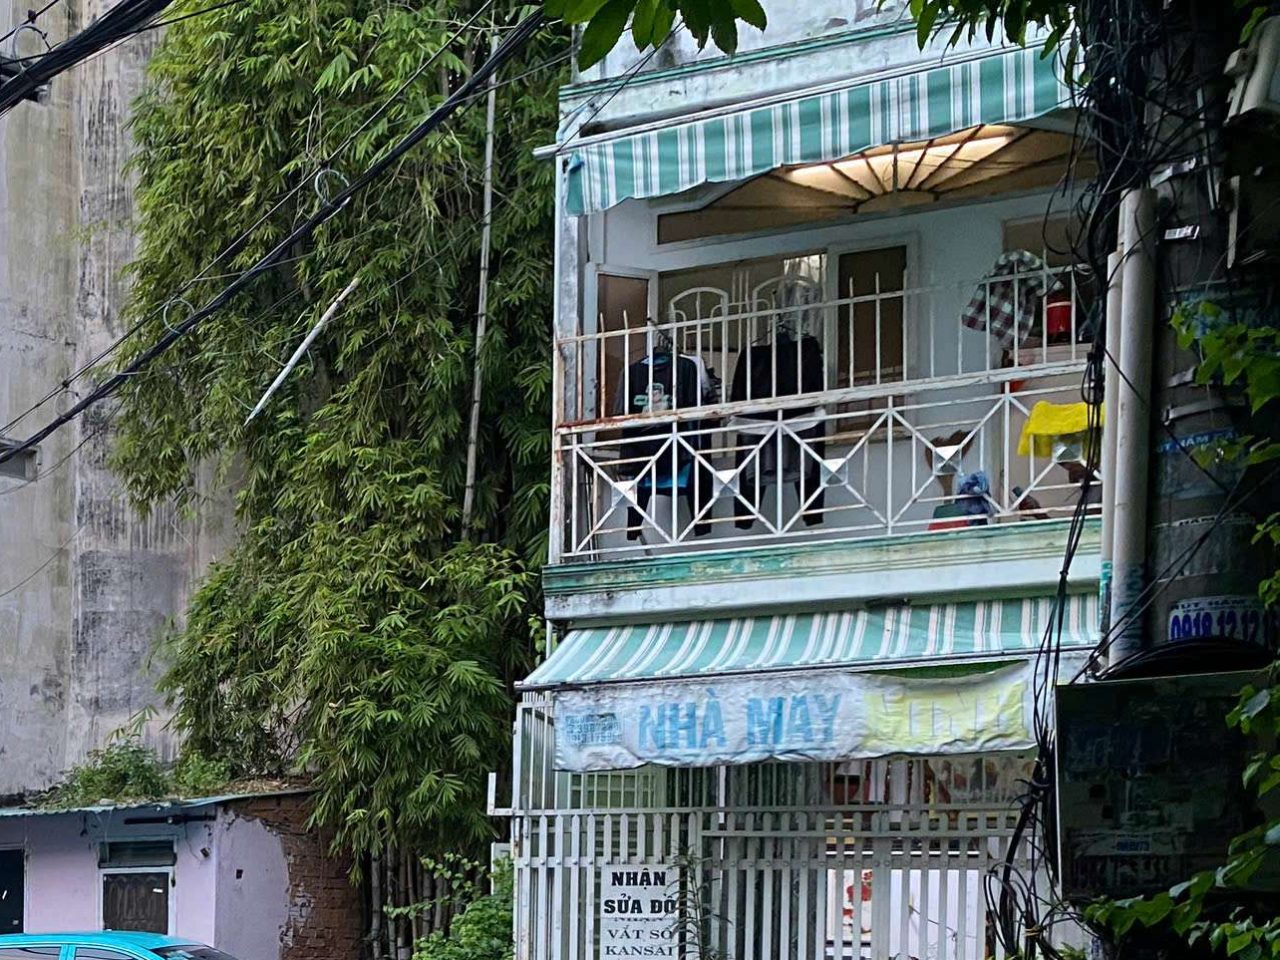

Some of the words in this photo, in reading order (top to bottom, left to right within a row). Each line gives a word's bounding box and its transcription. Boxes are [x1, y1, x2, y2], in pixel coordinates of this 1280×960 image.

[638, 687, 727, 750] NHÀ
[611, 867, 667, 890] NHẬN
[603, 893, 643, 914] SỬA
[605, 945, 673, 956] KANSAI
